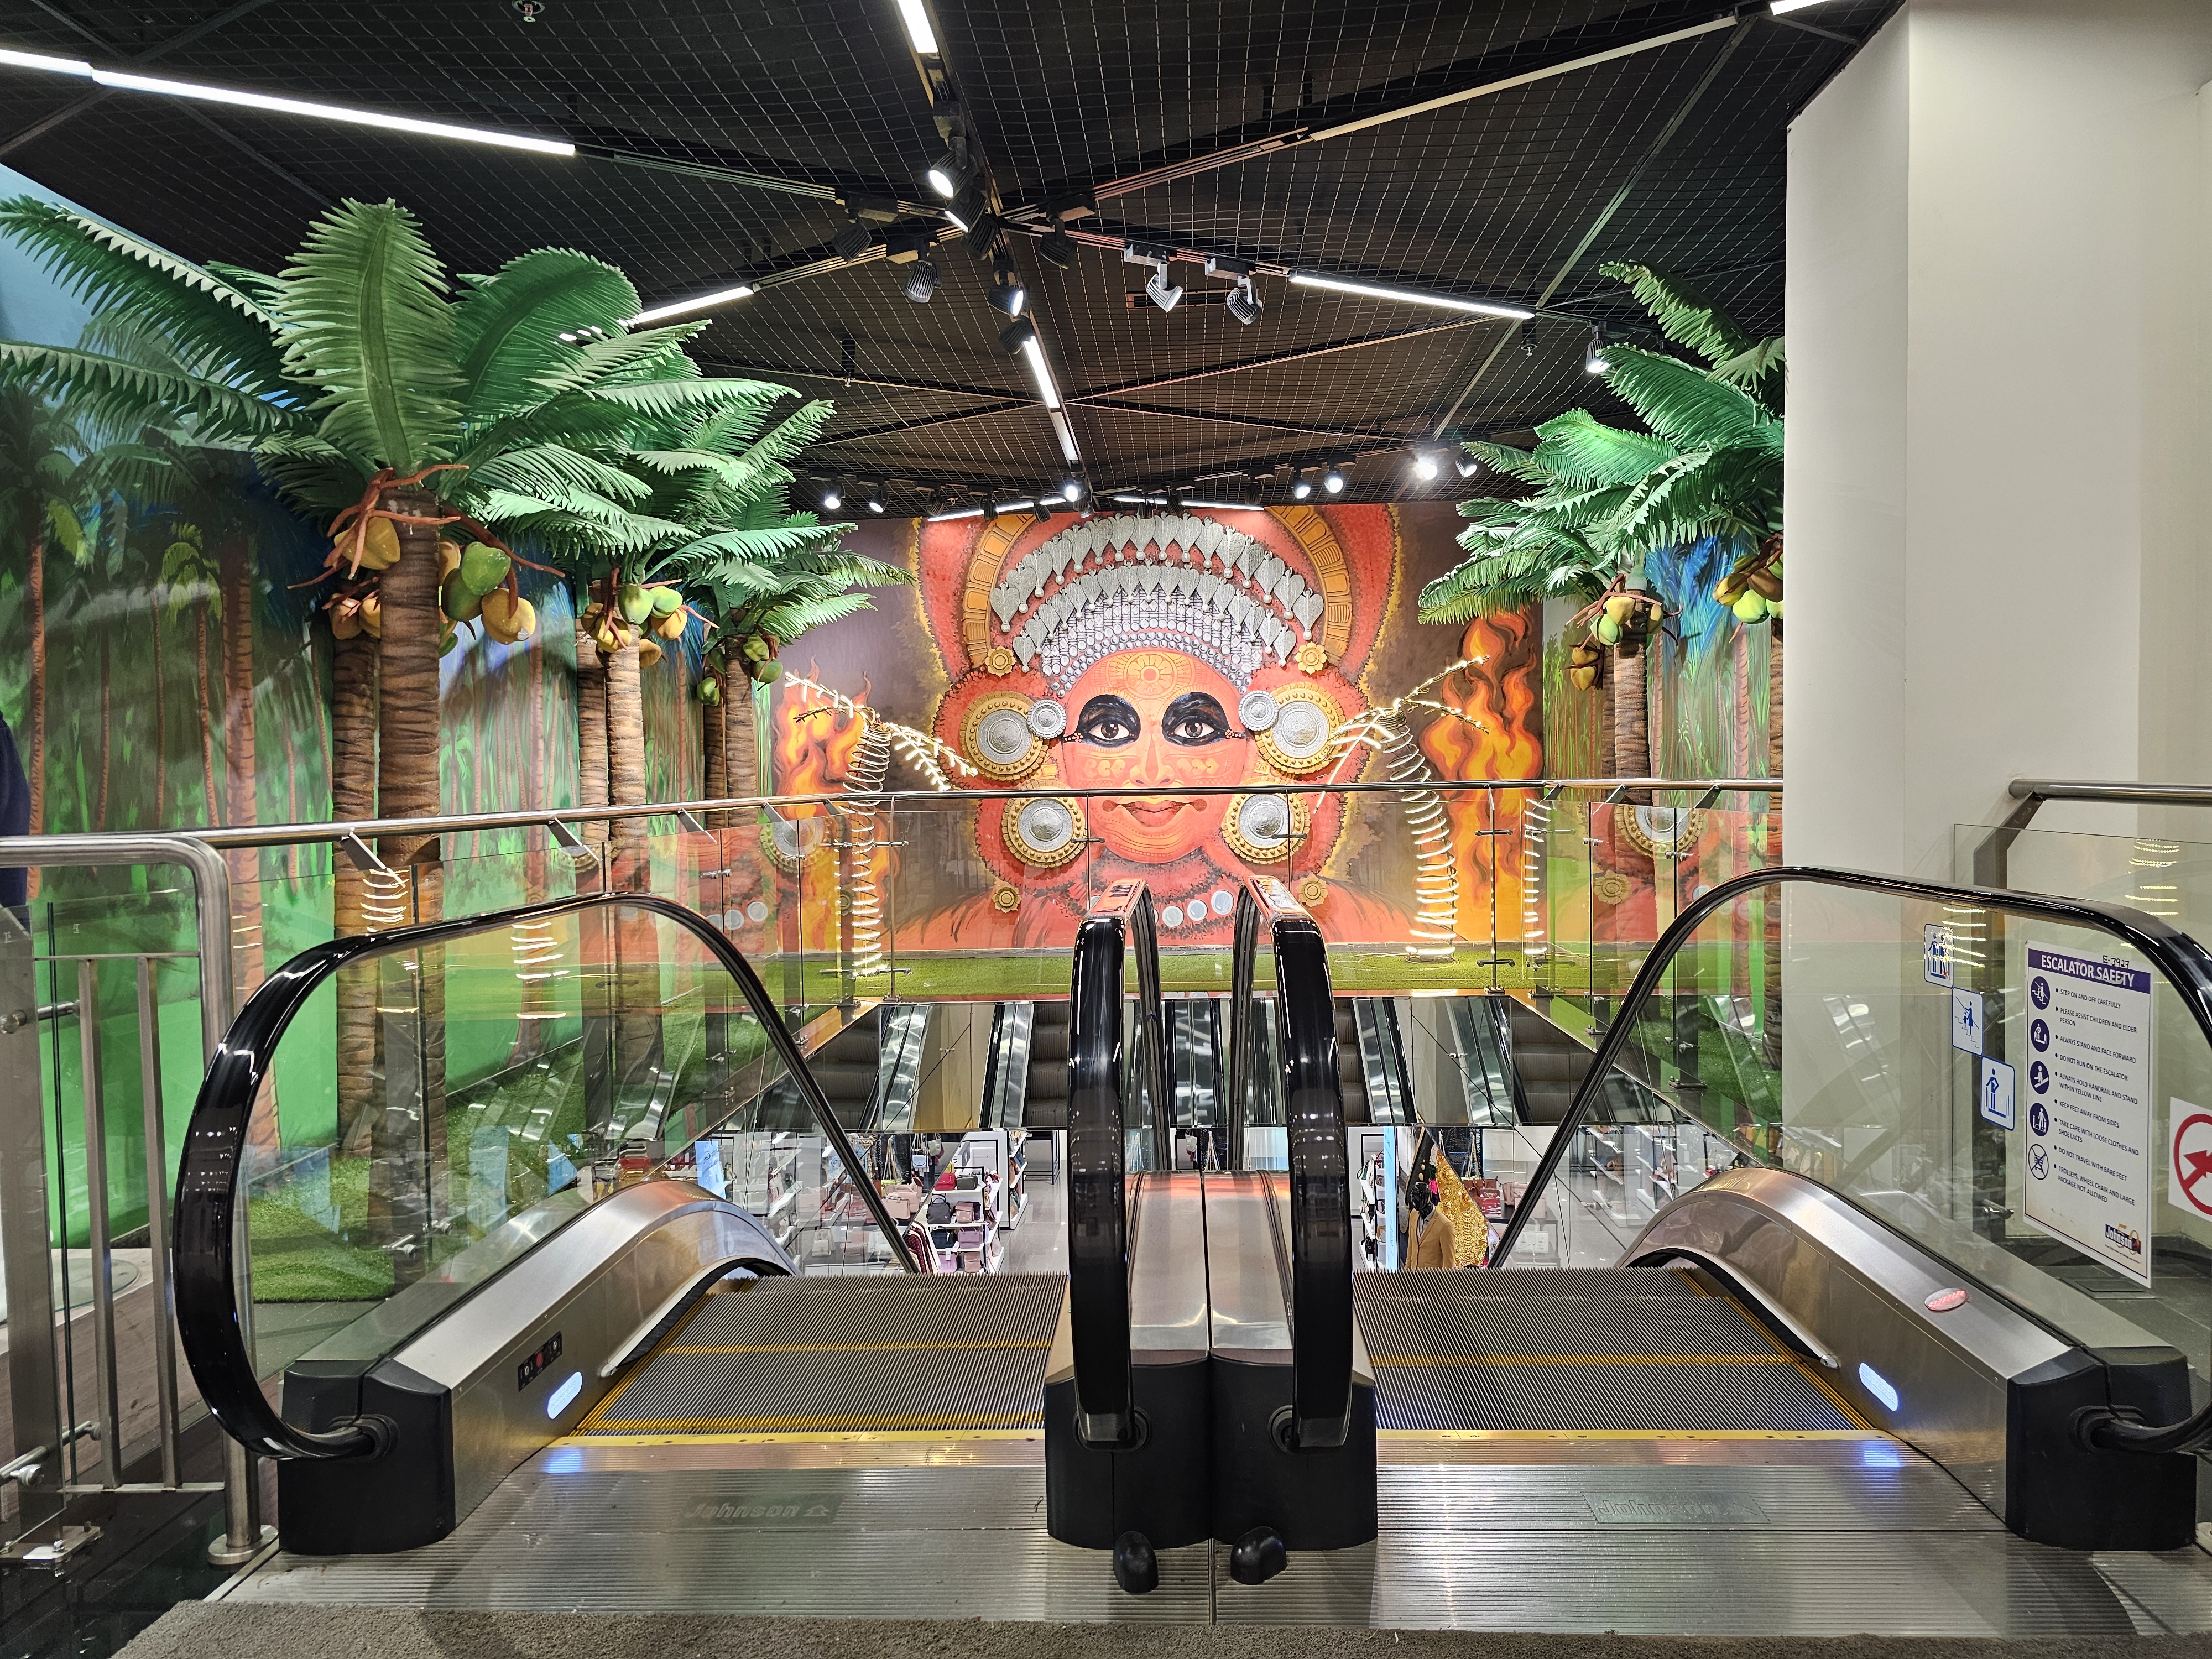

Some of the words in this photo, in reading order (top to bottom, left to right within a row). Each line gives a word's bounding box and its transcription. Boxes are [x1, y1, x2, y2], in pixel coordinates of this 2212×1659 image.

[2042, 954, 2094, 978] ESCALATOR
[2096, 967, 2134, 987] SAFETY
[2103, 955, 2129, 968] E-3927
[2098, 997, 2121, 1009] CAREFULLY
[2060, 1008, 2074, 1016] PLEASE
[2090, 1016, 2110, 1026] CHILDREN
[2123, 1024, 2137, 1032] ELDER
[2060, 1018, 2075, 1026] PERSON
[2060, 1036, 2075, 1045] ALWAYS
[2077, 1041, 2090, 1050] STAND
[2113, 1051, 2136, 1063] FORWARD
[2103, 1069, 2128, 1081] ESCALATOR
[2059, 1082, 2074, 1092] WITHIN
[2075, 1088, 2091, 1098] YELLOW
[2093, 1094, 2102, 1102] LINE
[2060, 1073, 2075, 1083] ALWAYS
[2076, 1078, 2087, 1087] HOLD
[2089, 1082, 2110, 1095] HANDRAIL
[2122, 1095, 2137, 1104] STAND
[2080, 1109, 2091, 1118] AWAY
[2093, 1114, 2106, 1123] FROM
[2107, 1119, 2119, 1128] SIDES
[2059, 1129, 2069, 1138] SHOE
[2059, 1119, 2069, 1128] TAKE
[2070, 1124, 2080, 1132] CARE
[2081, 1128, 2092, 1136] WITH
[2093, 1134, 2107, 1143] LOOSE
[2108, 1139, 2127, 1151] CLOTHES
[2066, 1150, 2074, 1159] NOT
[2075, 1155, 2090, 1166] TRAVEL
[2091, 1161, 2103, 1171] WITH
[2104, 1167, 2115, 1177] BARE
[2116, 1172, 2127, 1181] FEET
[2058, 1175, 2076, 1188] PACKAGE
[2086, 1189, 2107, 1203] ALLOWED
[2059, 1166, 2079, 1180] TROLLEYS,
[2080, 1176, 2094, 1187] WHEEL
[2095, 1183, 2108, 1193] CHAIR
[2109, 1189, 2119, 1198] AND
[2120, 1193, 2135, 1206] LARGE
[2106, 1226, 2132, 1249] Johnson
[685, 1503, 800, 1519] Johnson
[1597, 1500, 1718, 1515] Johnson
